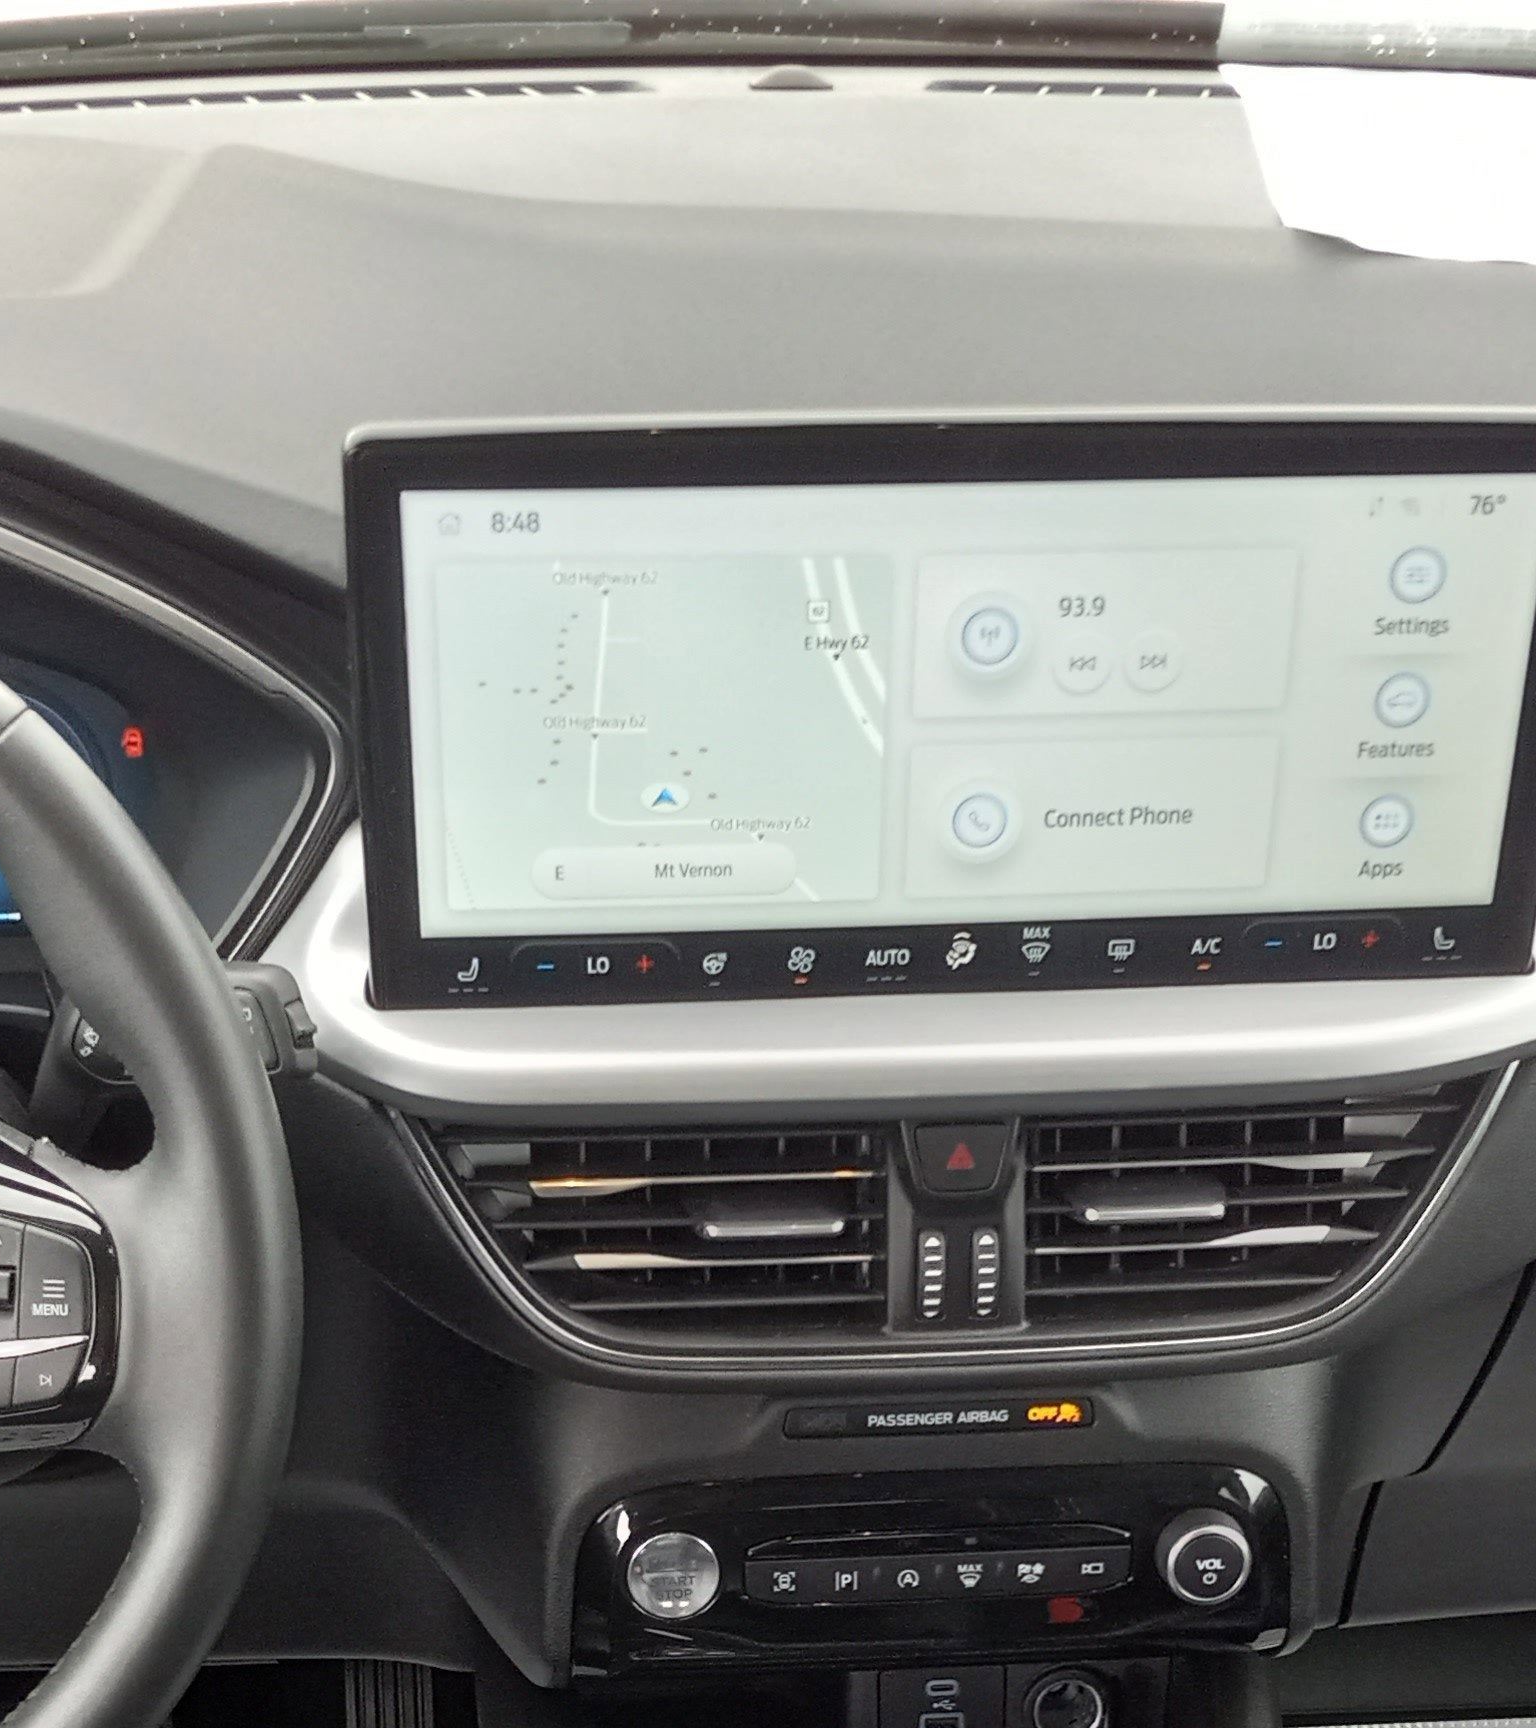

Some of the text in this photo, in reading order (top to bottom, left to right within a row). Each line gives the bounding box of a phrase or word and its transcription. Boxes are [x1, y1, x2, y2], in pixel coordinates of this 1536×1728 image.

[491, 511, 540, 534] 8:48
[553, 570, 658, 588] Old Highway 62
[1058, 596, 1107, 618] 93.9
[1374, 616, 1449, 637] Settings
[804, 634, 870, 652] E Hwy 62
[542, 714, 646, 732] Old Highway 62
[1358, 740, 1435, 759] Features
[710, 815, 810, 833] Old Highway 62
[1044, 804, 1192, 829] Connect Phone
[555, 866, 564, 881] E
[655, 861, 733, 879] Mt Vernon
[1358, 859, 1403, 881] Apps
[1022, 927, 1051, 939] MAX
[1191, 936, 1222, 955] A/C
[1313, 933, 1336, 952] LO
[587, 957, 610, 974] LO
[866, 949, 911, 967] AUTO
[32, 1303, 69, 1316] MENU
[867, 1410, 1009, 1427] PASSENGER AIRBAG
[1027, 1406, 1059, 1421] OFF
[957, 1563, 983, 1573] MAX
[1196, 1559, 1225, 1571] VOL
[651, 1576, 696, 1586] START
[656, 1590, 693, 1600] STOP
